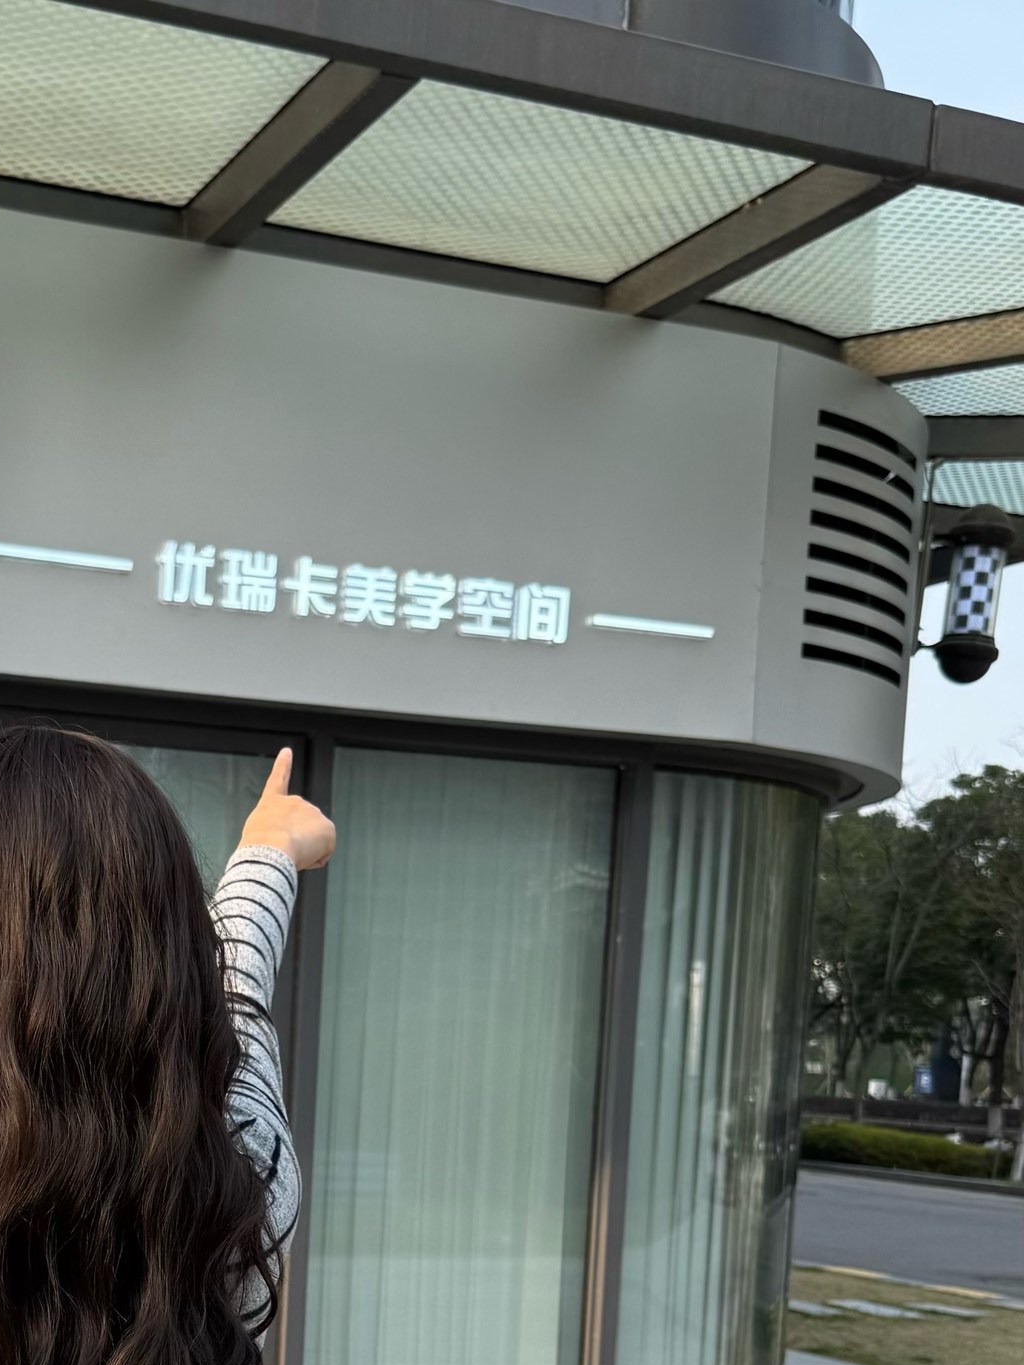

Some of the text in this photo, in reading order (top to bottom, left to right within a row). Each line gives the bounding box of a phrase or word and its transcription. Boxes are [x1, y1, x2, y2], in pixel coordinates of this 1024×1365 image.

[156, 540, 571, 644] 优瑞卡美学空间
